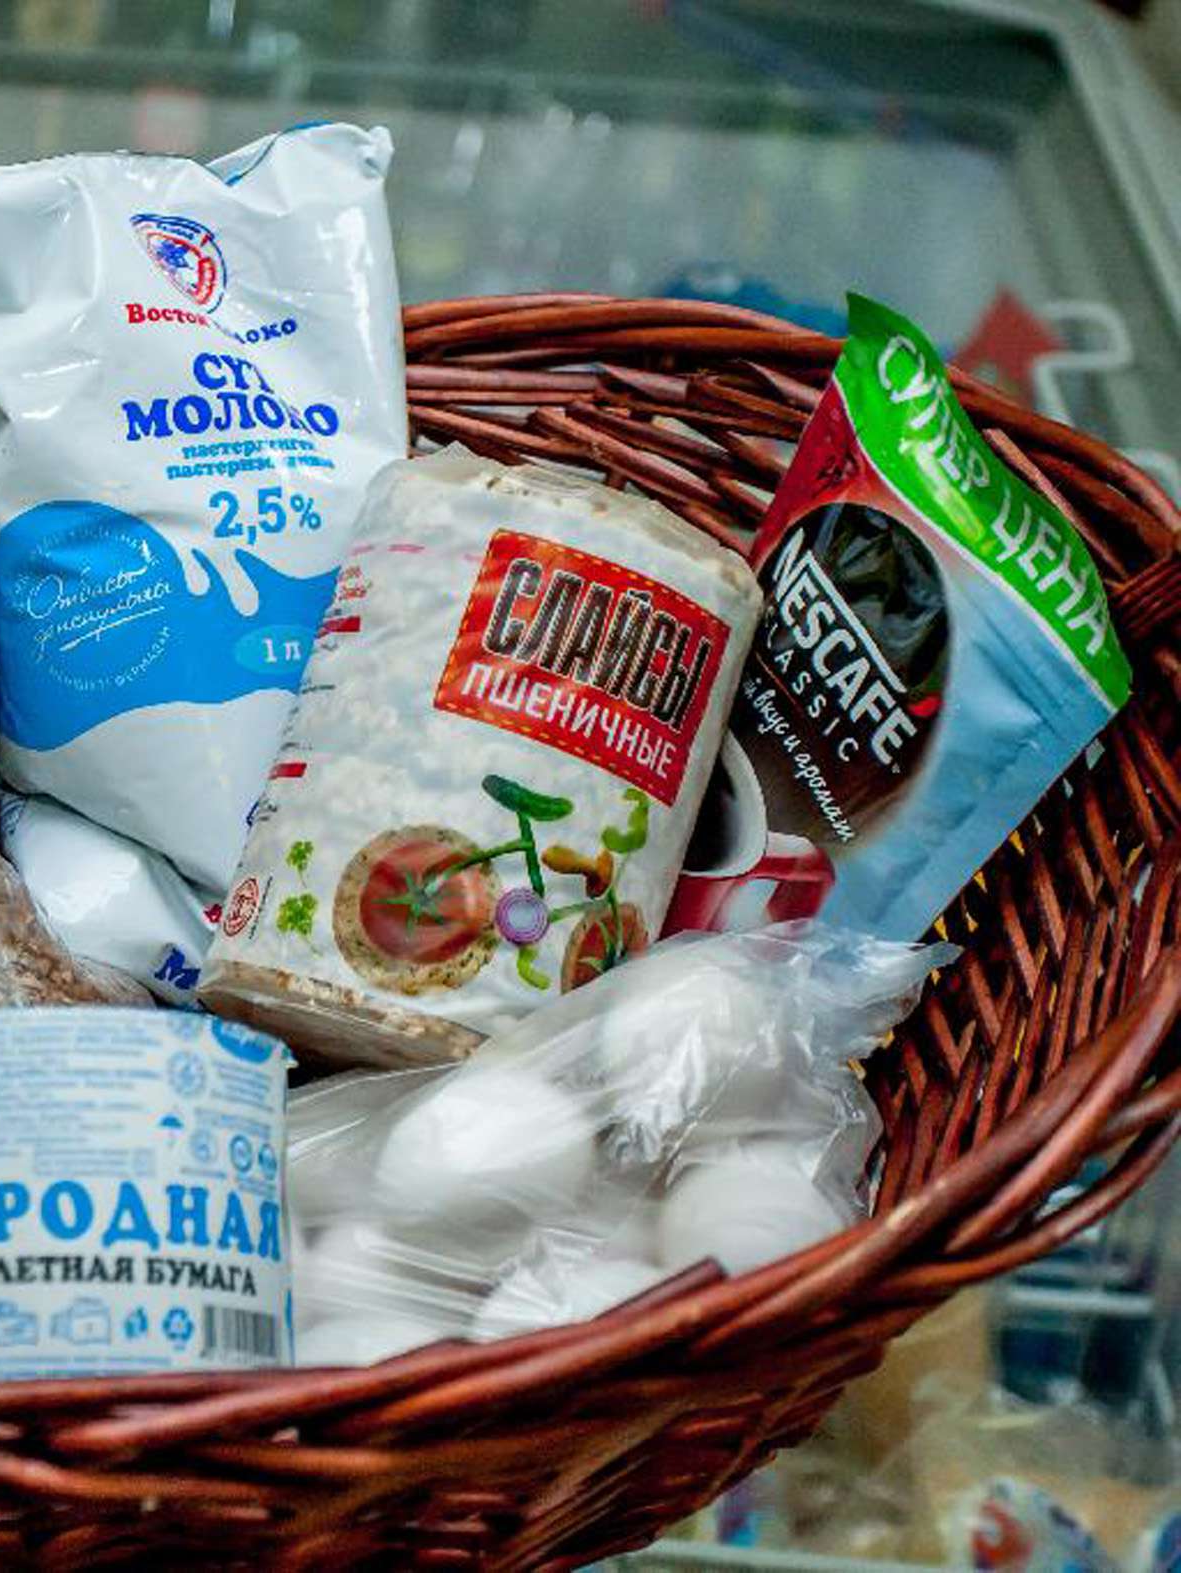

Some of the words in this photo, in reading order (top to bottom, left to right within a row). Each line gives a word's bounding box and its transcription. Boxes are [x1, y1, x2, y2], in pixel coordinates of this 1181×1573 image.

[876, 333, 991, 493] СУПЕР
[990, 486, 1109, 657] ЦЕНА
[263, 638, 278, 663] 1
[482, 557, 712, 734] СЛАЙСЫ
[461, 663, 677, 778] ПШЕНИЧНЫЕ
[751, 688, 789, 735] вкус
[795, 751, 856, 842] аромат
[146, 1257, 256, 1297] БУМАГА
